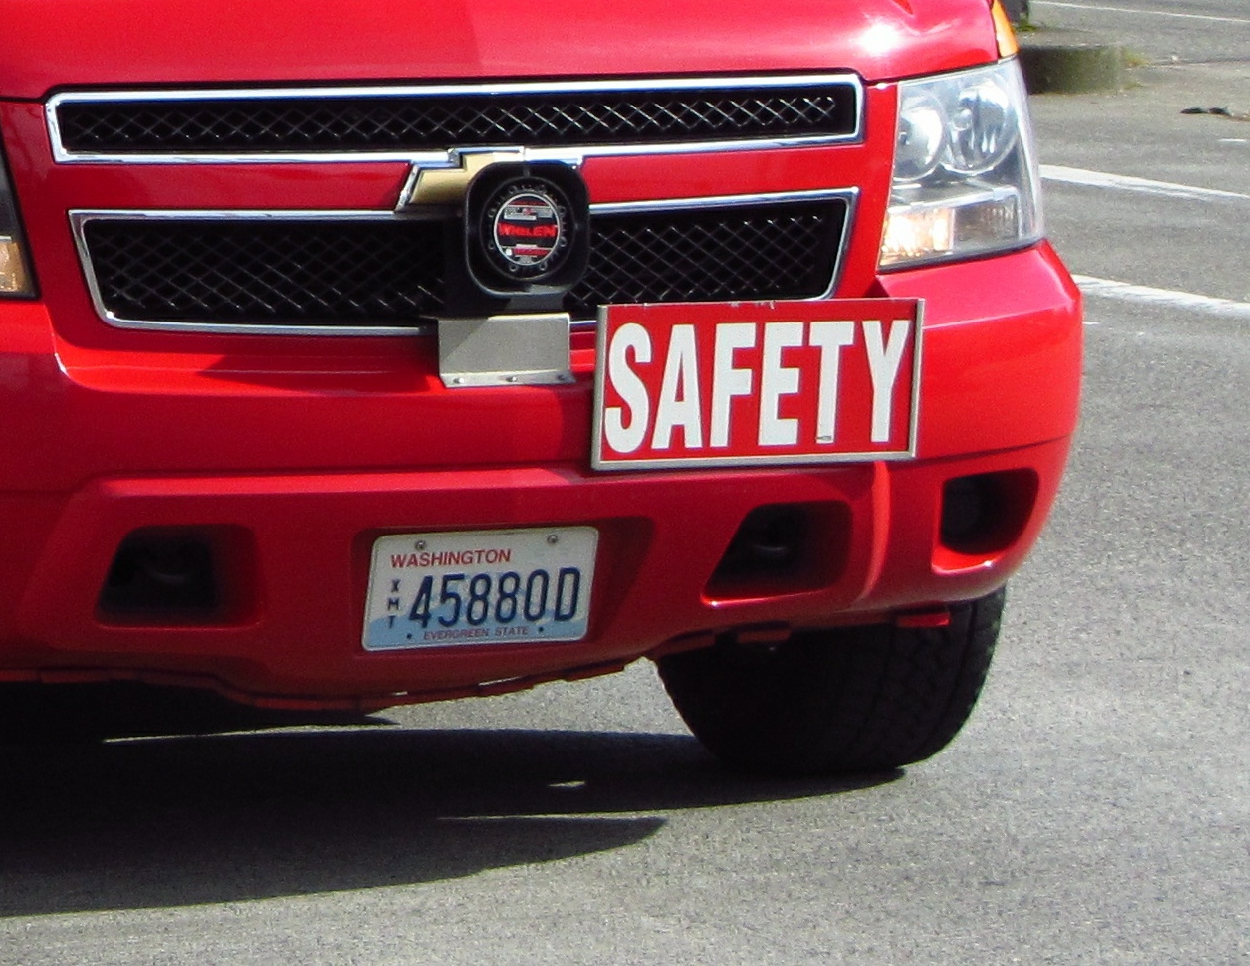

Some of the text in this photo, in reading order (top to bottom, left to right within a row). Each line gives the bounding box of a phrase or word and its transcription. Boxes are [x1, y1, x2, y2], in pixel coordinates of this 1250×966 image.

[604, 320, 910, 454] SAFETY
[390, 548, 511, 568] WASHINGTON
[409, 566, 581, 629] 45880D
[423, 625, 529, 640] EVERGREEN STATE
